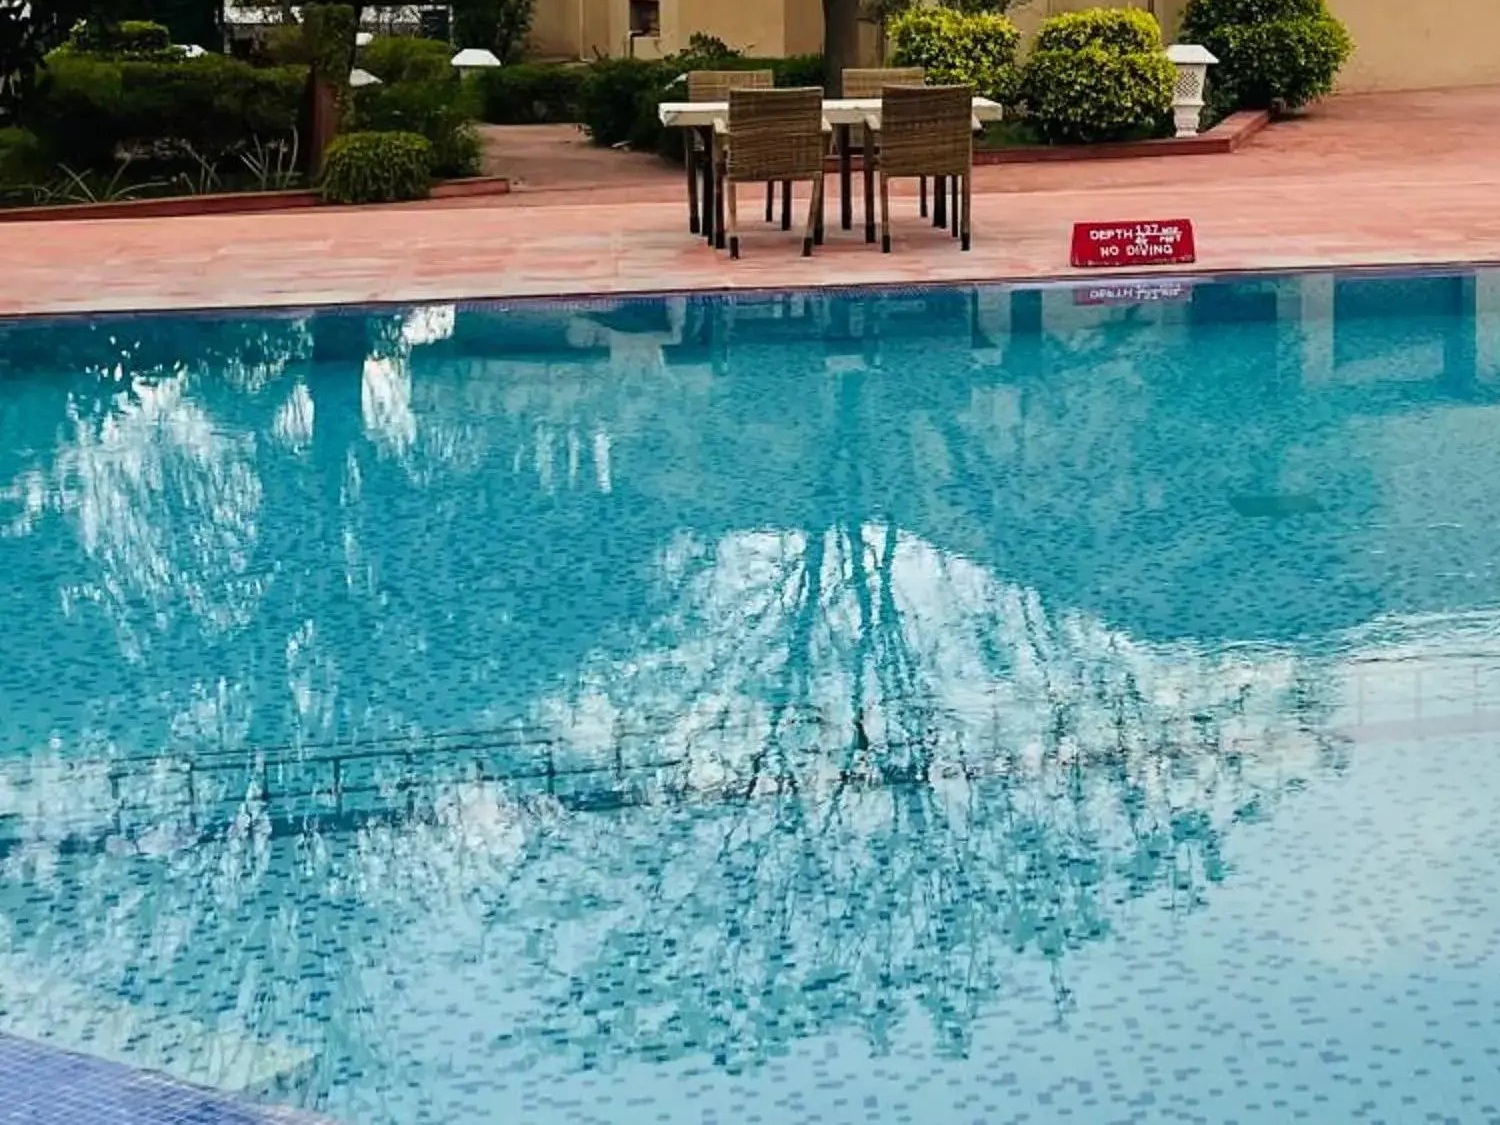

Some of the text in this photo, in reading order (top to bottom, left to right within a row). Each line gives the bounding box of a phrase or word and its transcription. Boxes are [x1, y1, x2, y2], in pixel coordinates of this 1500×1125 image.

[1089, 228, 1133, 241] DEPTH
[1100, 244, 1173, 257] NO DIVING
